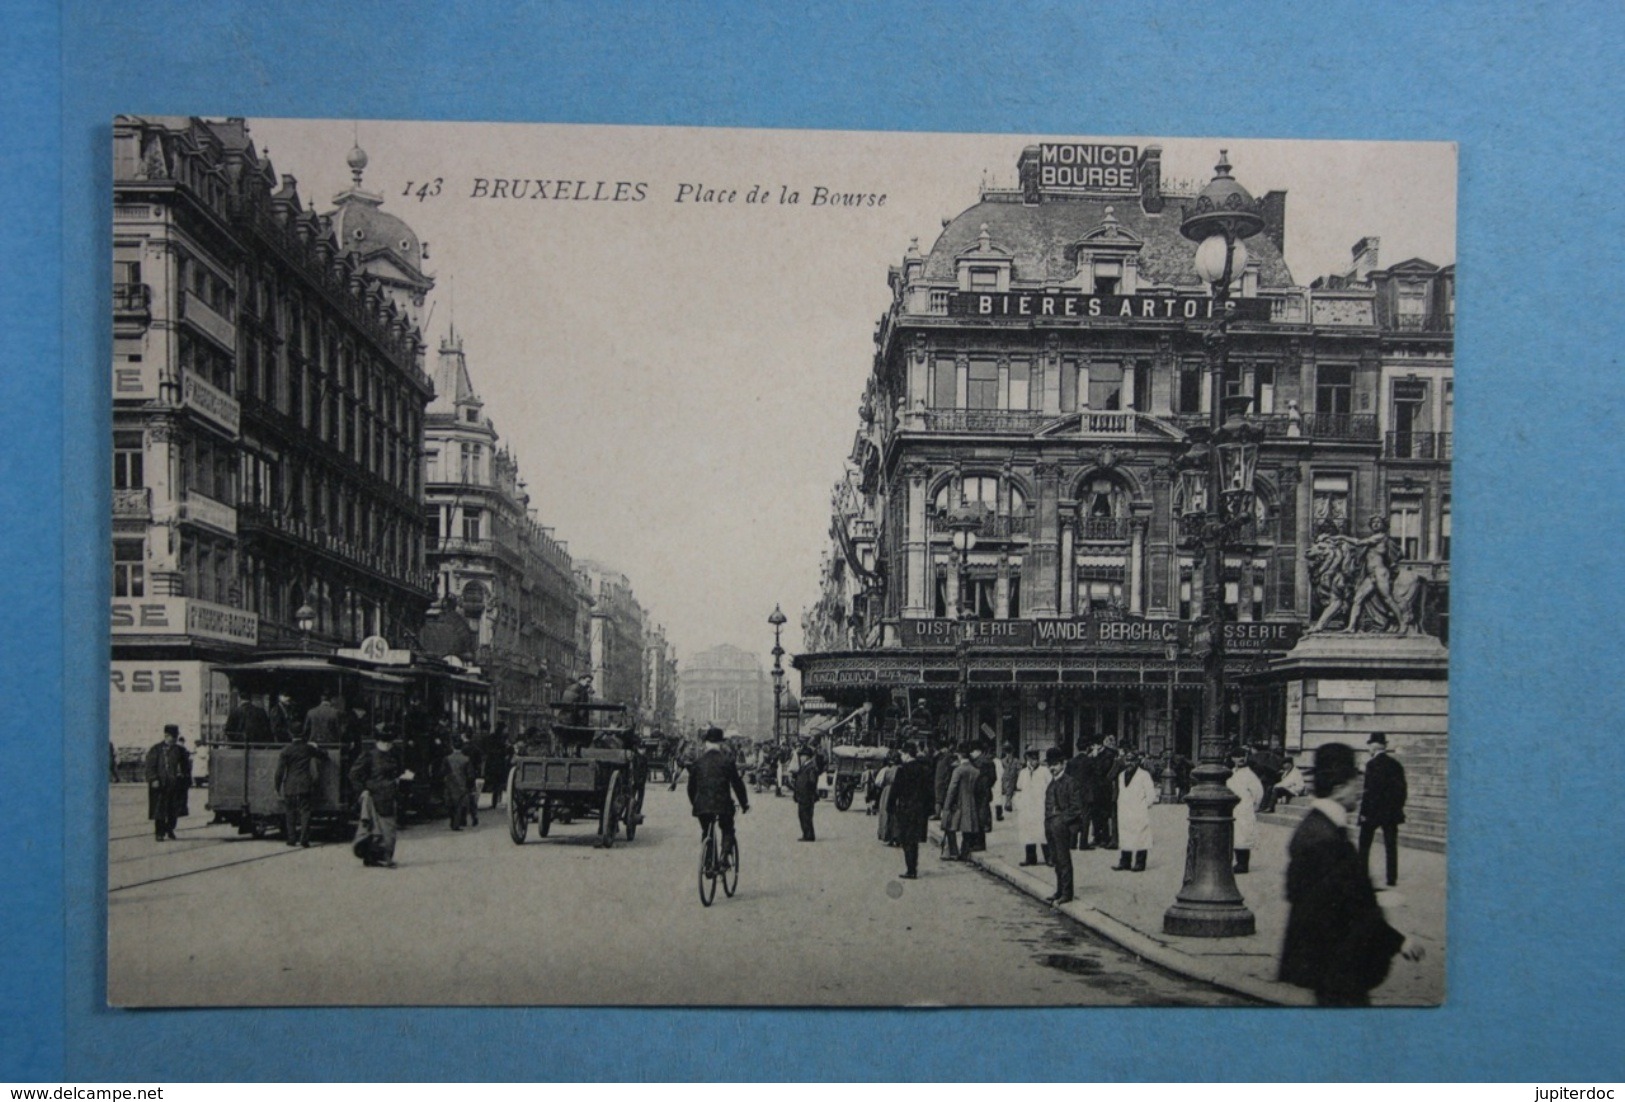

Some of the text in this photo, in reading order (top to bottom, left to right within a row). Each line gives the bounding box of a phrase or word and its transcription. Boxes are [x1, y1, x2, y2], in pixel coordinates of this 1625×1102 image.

[1042, 144, 1135, 165] MONICO
[1042, 166, 1134, 187] BOURSE
[402, 178, 887, 207] 143 BRUXELLES Place de la Bourse
[1038, 622, 1087, 640] VANDE
[364, 639, 385, 659] 49
